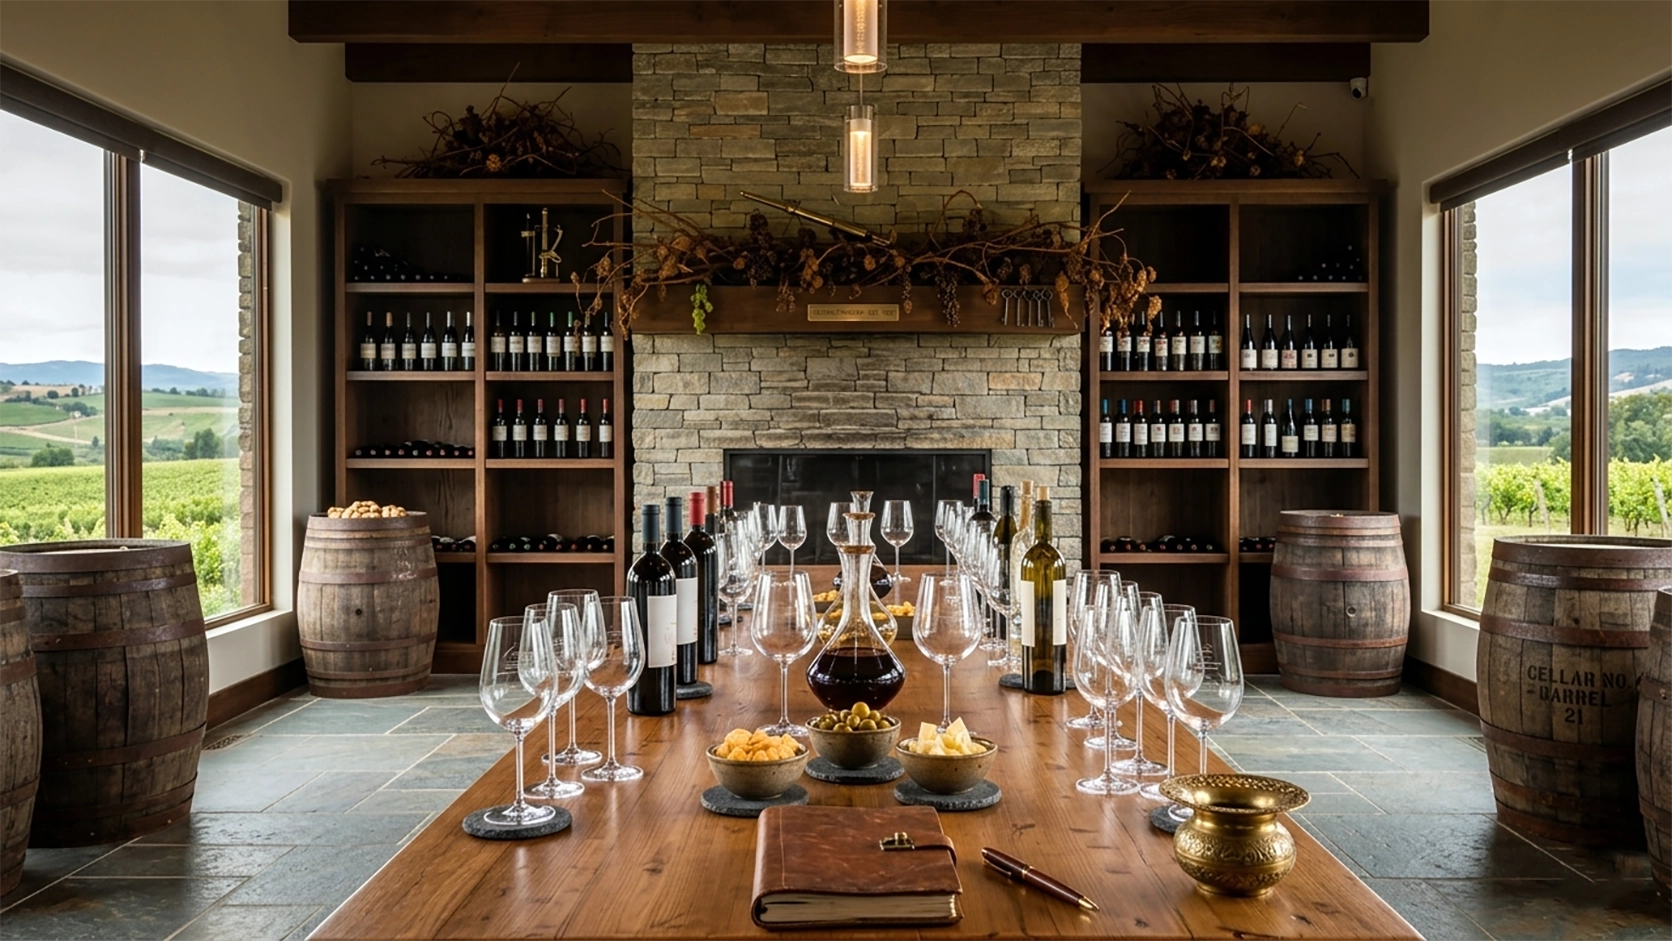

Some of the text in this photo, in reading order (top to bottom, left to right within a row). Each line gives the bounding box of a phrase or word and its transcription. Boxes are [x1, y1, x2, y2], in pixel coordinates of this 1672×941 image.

[1527, 665, 1631, 689] CELLAR NO.
[1565, 708, 1583, 725] 21
